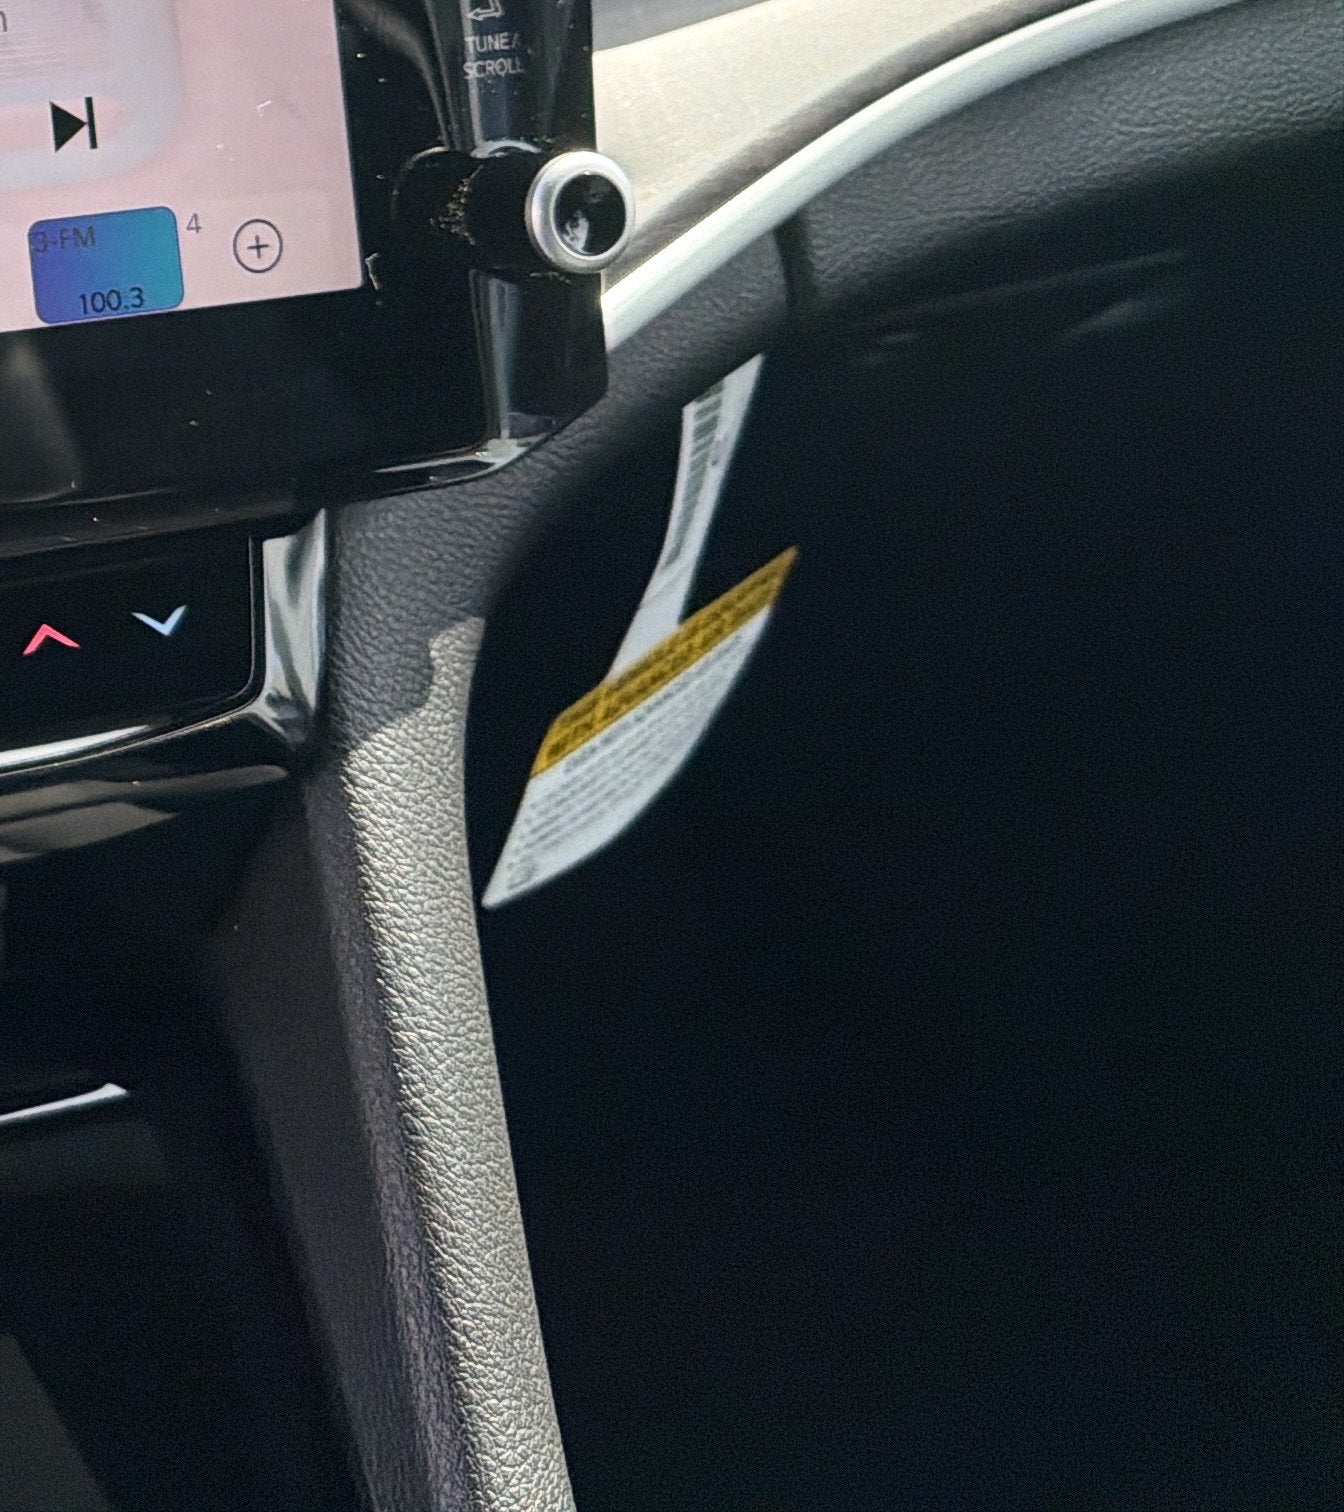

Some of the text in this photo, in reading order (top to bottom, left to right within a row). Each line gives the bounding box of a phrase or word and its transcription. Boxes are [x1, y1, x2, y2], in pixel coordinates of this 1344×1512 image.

[462, 55, 525, 79] SCROLL
[186, 212, 203, 235] 4
[79, 286, 145, 315] 100.3
